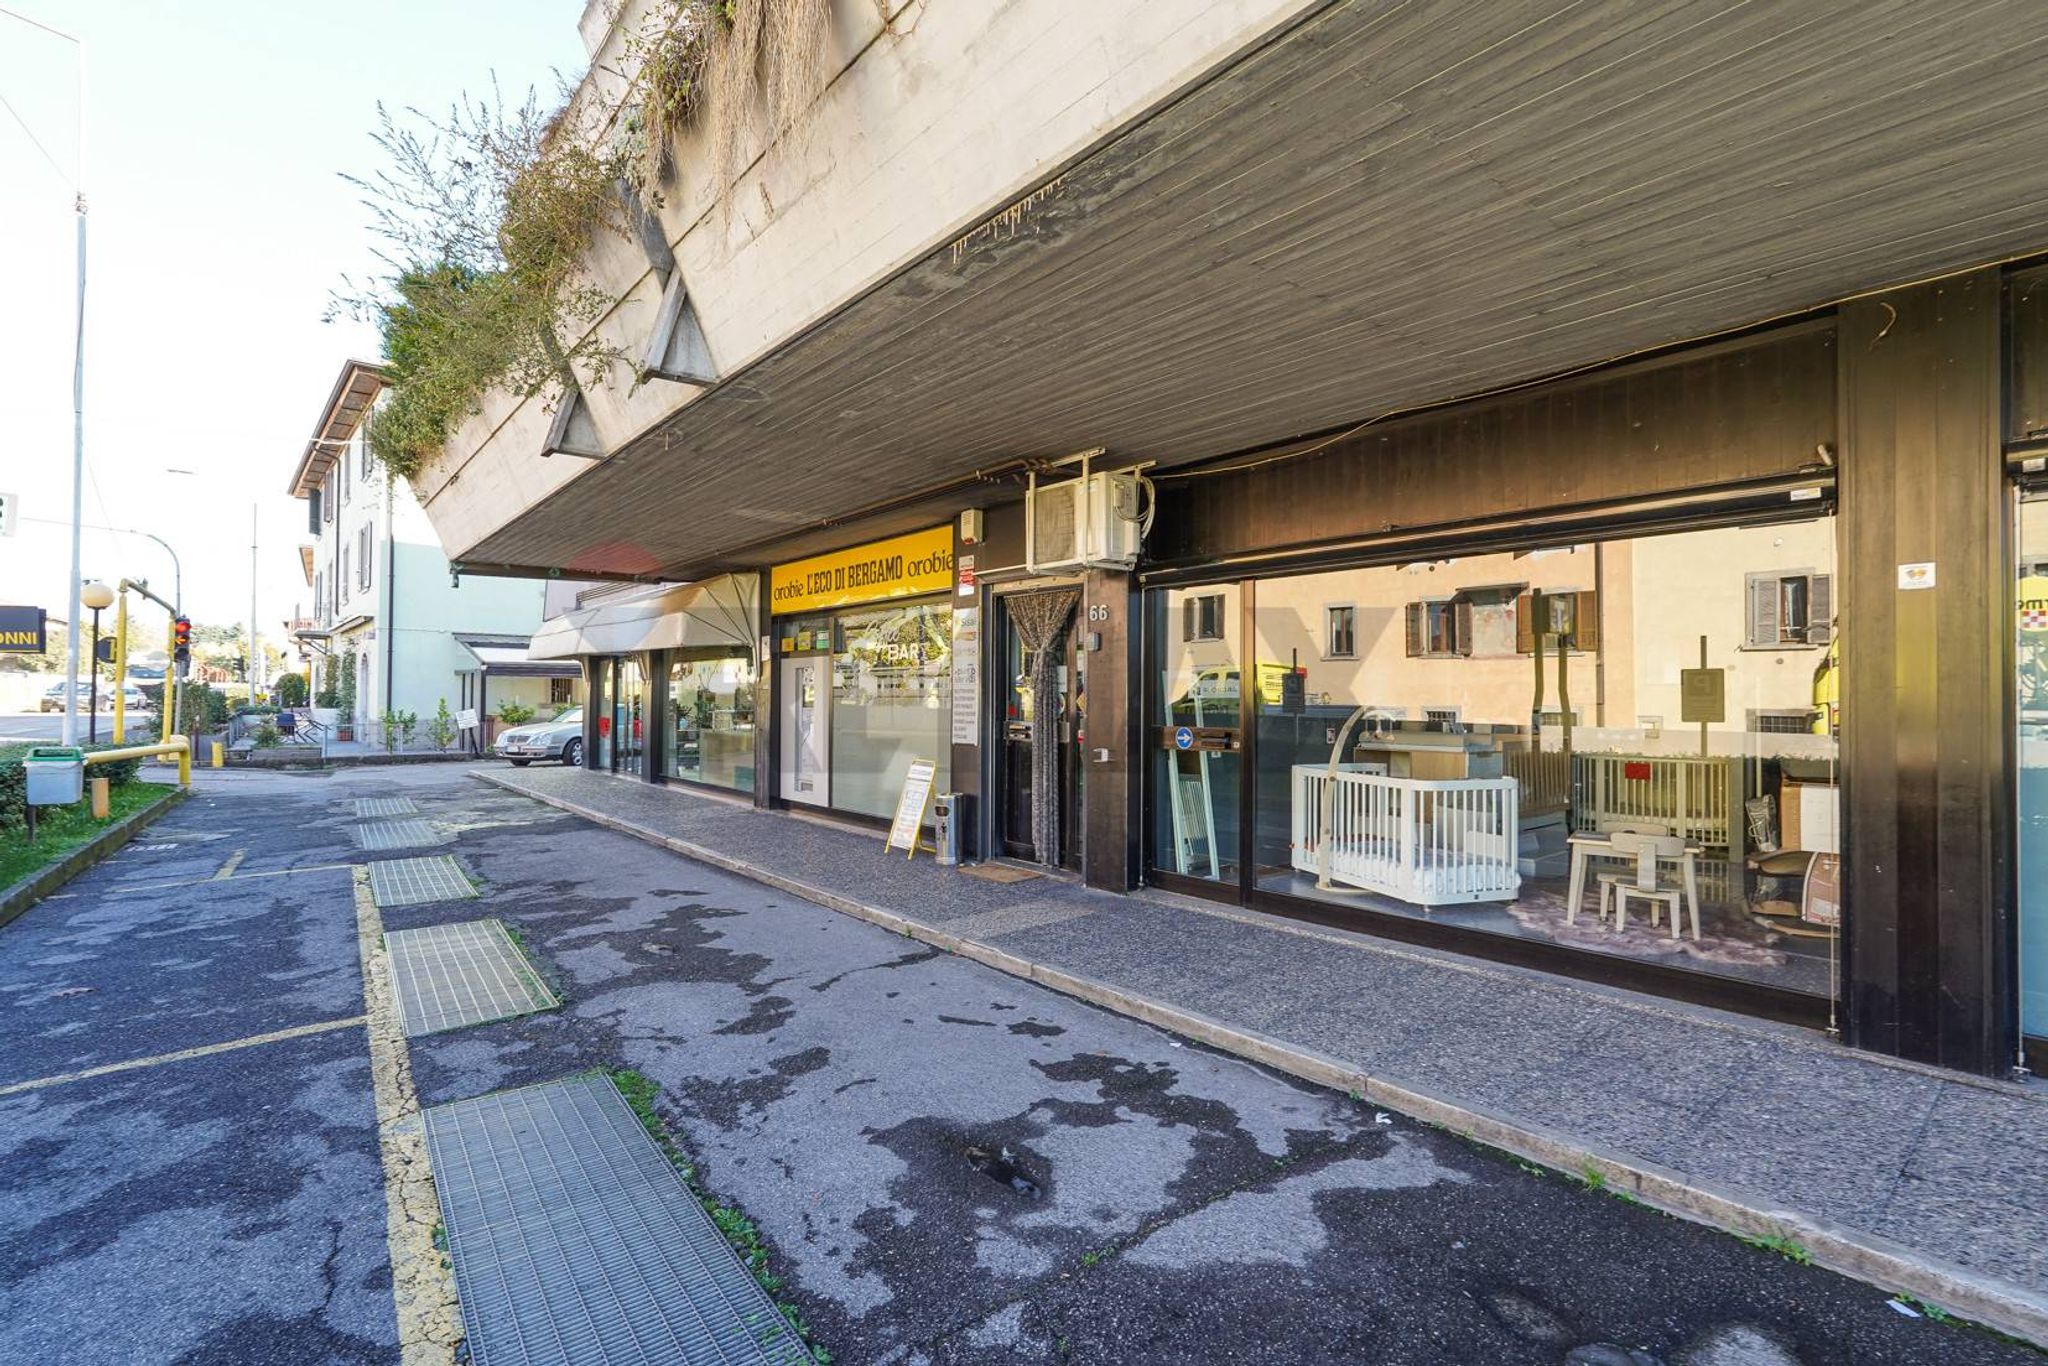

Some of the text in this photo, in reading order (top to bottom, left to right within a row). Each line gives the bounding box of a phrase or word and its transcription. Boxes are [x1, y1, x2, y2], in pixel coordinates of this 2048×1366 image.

[773, 579, 804, 601] orobie
[807, 570, 832, 595] L'ECO
[835, 567, 846, 591] DI
[848, 555, 903, 588] BERGAMO
[907, 550, 953, 577] orobie
[1089, 604, 1108, 621] 66
[887, 643, 919, 662] BAR
